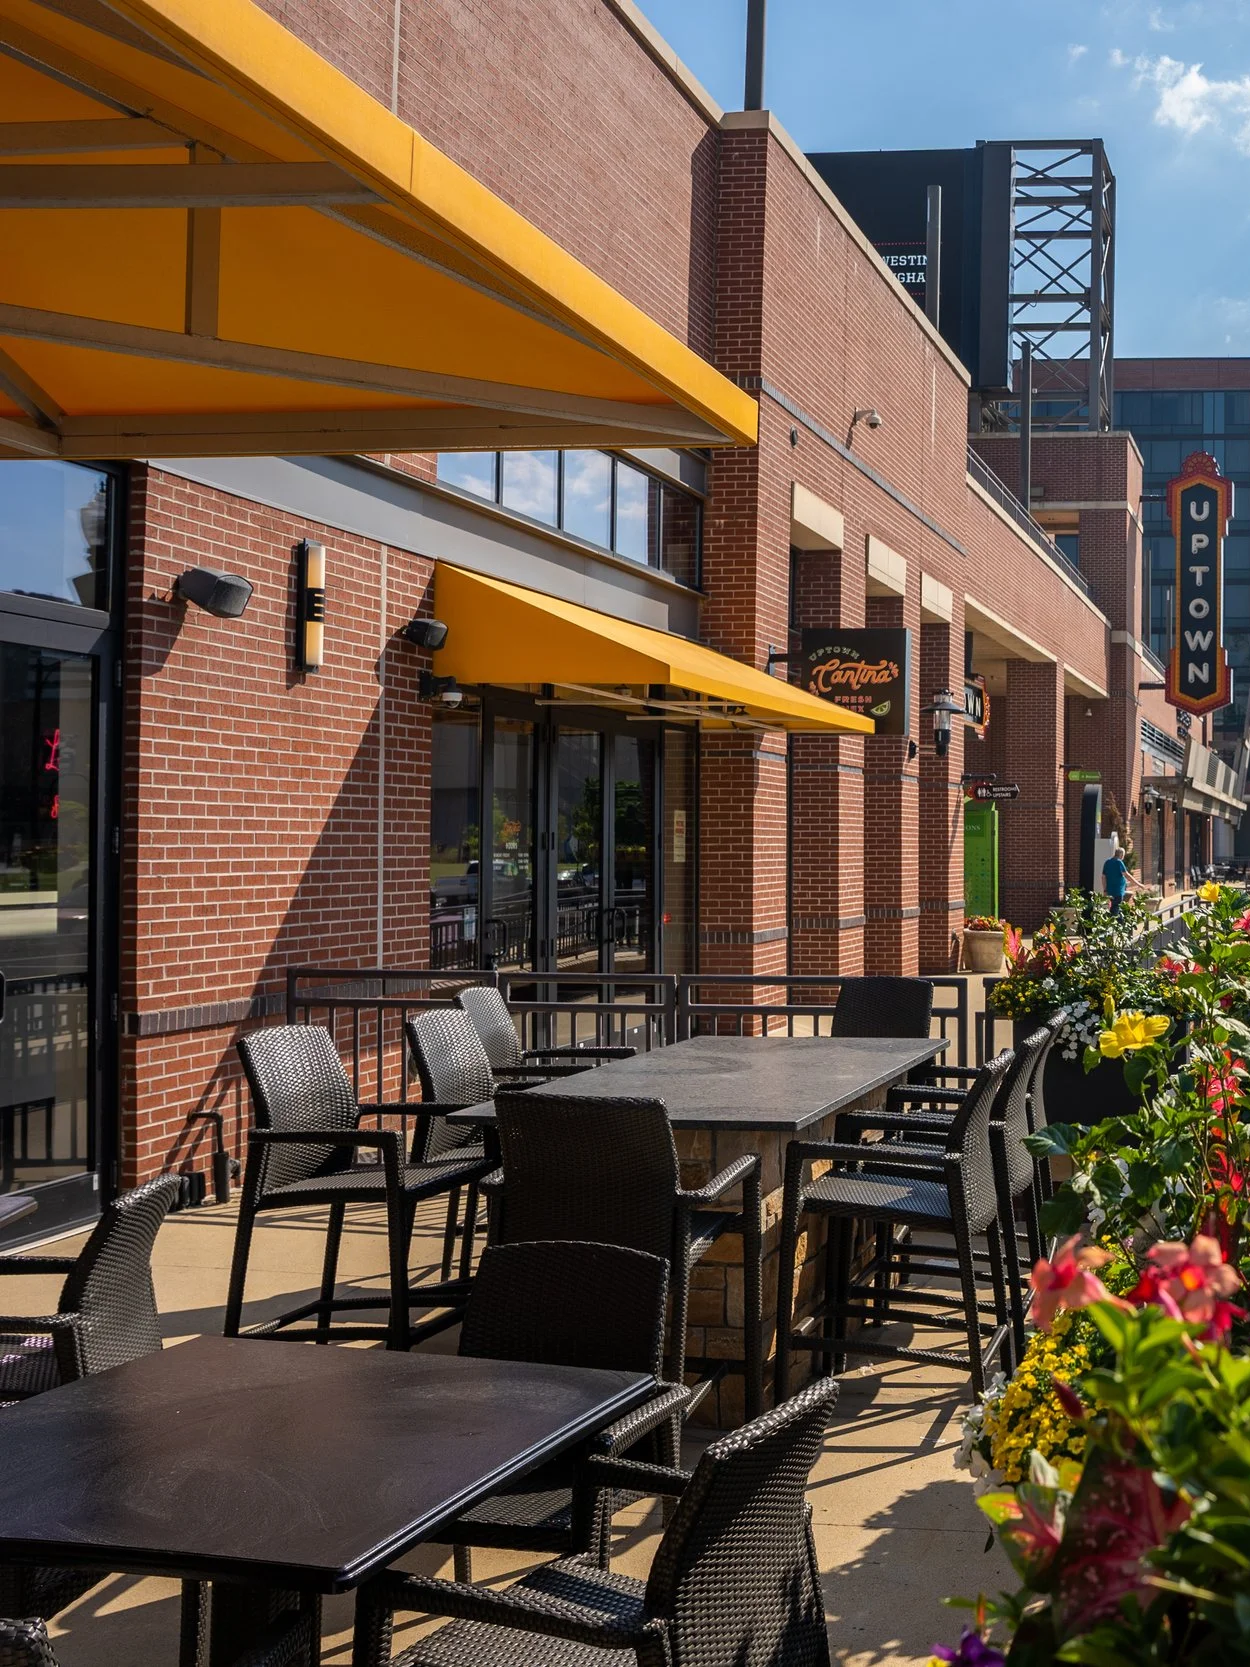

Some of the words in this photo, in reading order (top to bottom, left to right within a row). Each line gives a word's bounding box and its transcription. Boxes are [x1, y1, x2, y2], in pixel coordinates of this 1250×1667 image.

[893, 273, 926, 283] GHA
[1184, 501, 1214, 684] UPTOWN
[808, 646, 860, 661] UPTOWN
[811, 658, 893, 693] Cantina
[834, 695, 873, 704] FRESH
[964, 693, 981, 718] WN
